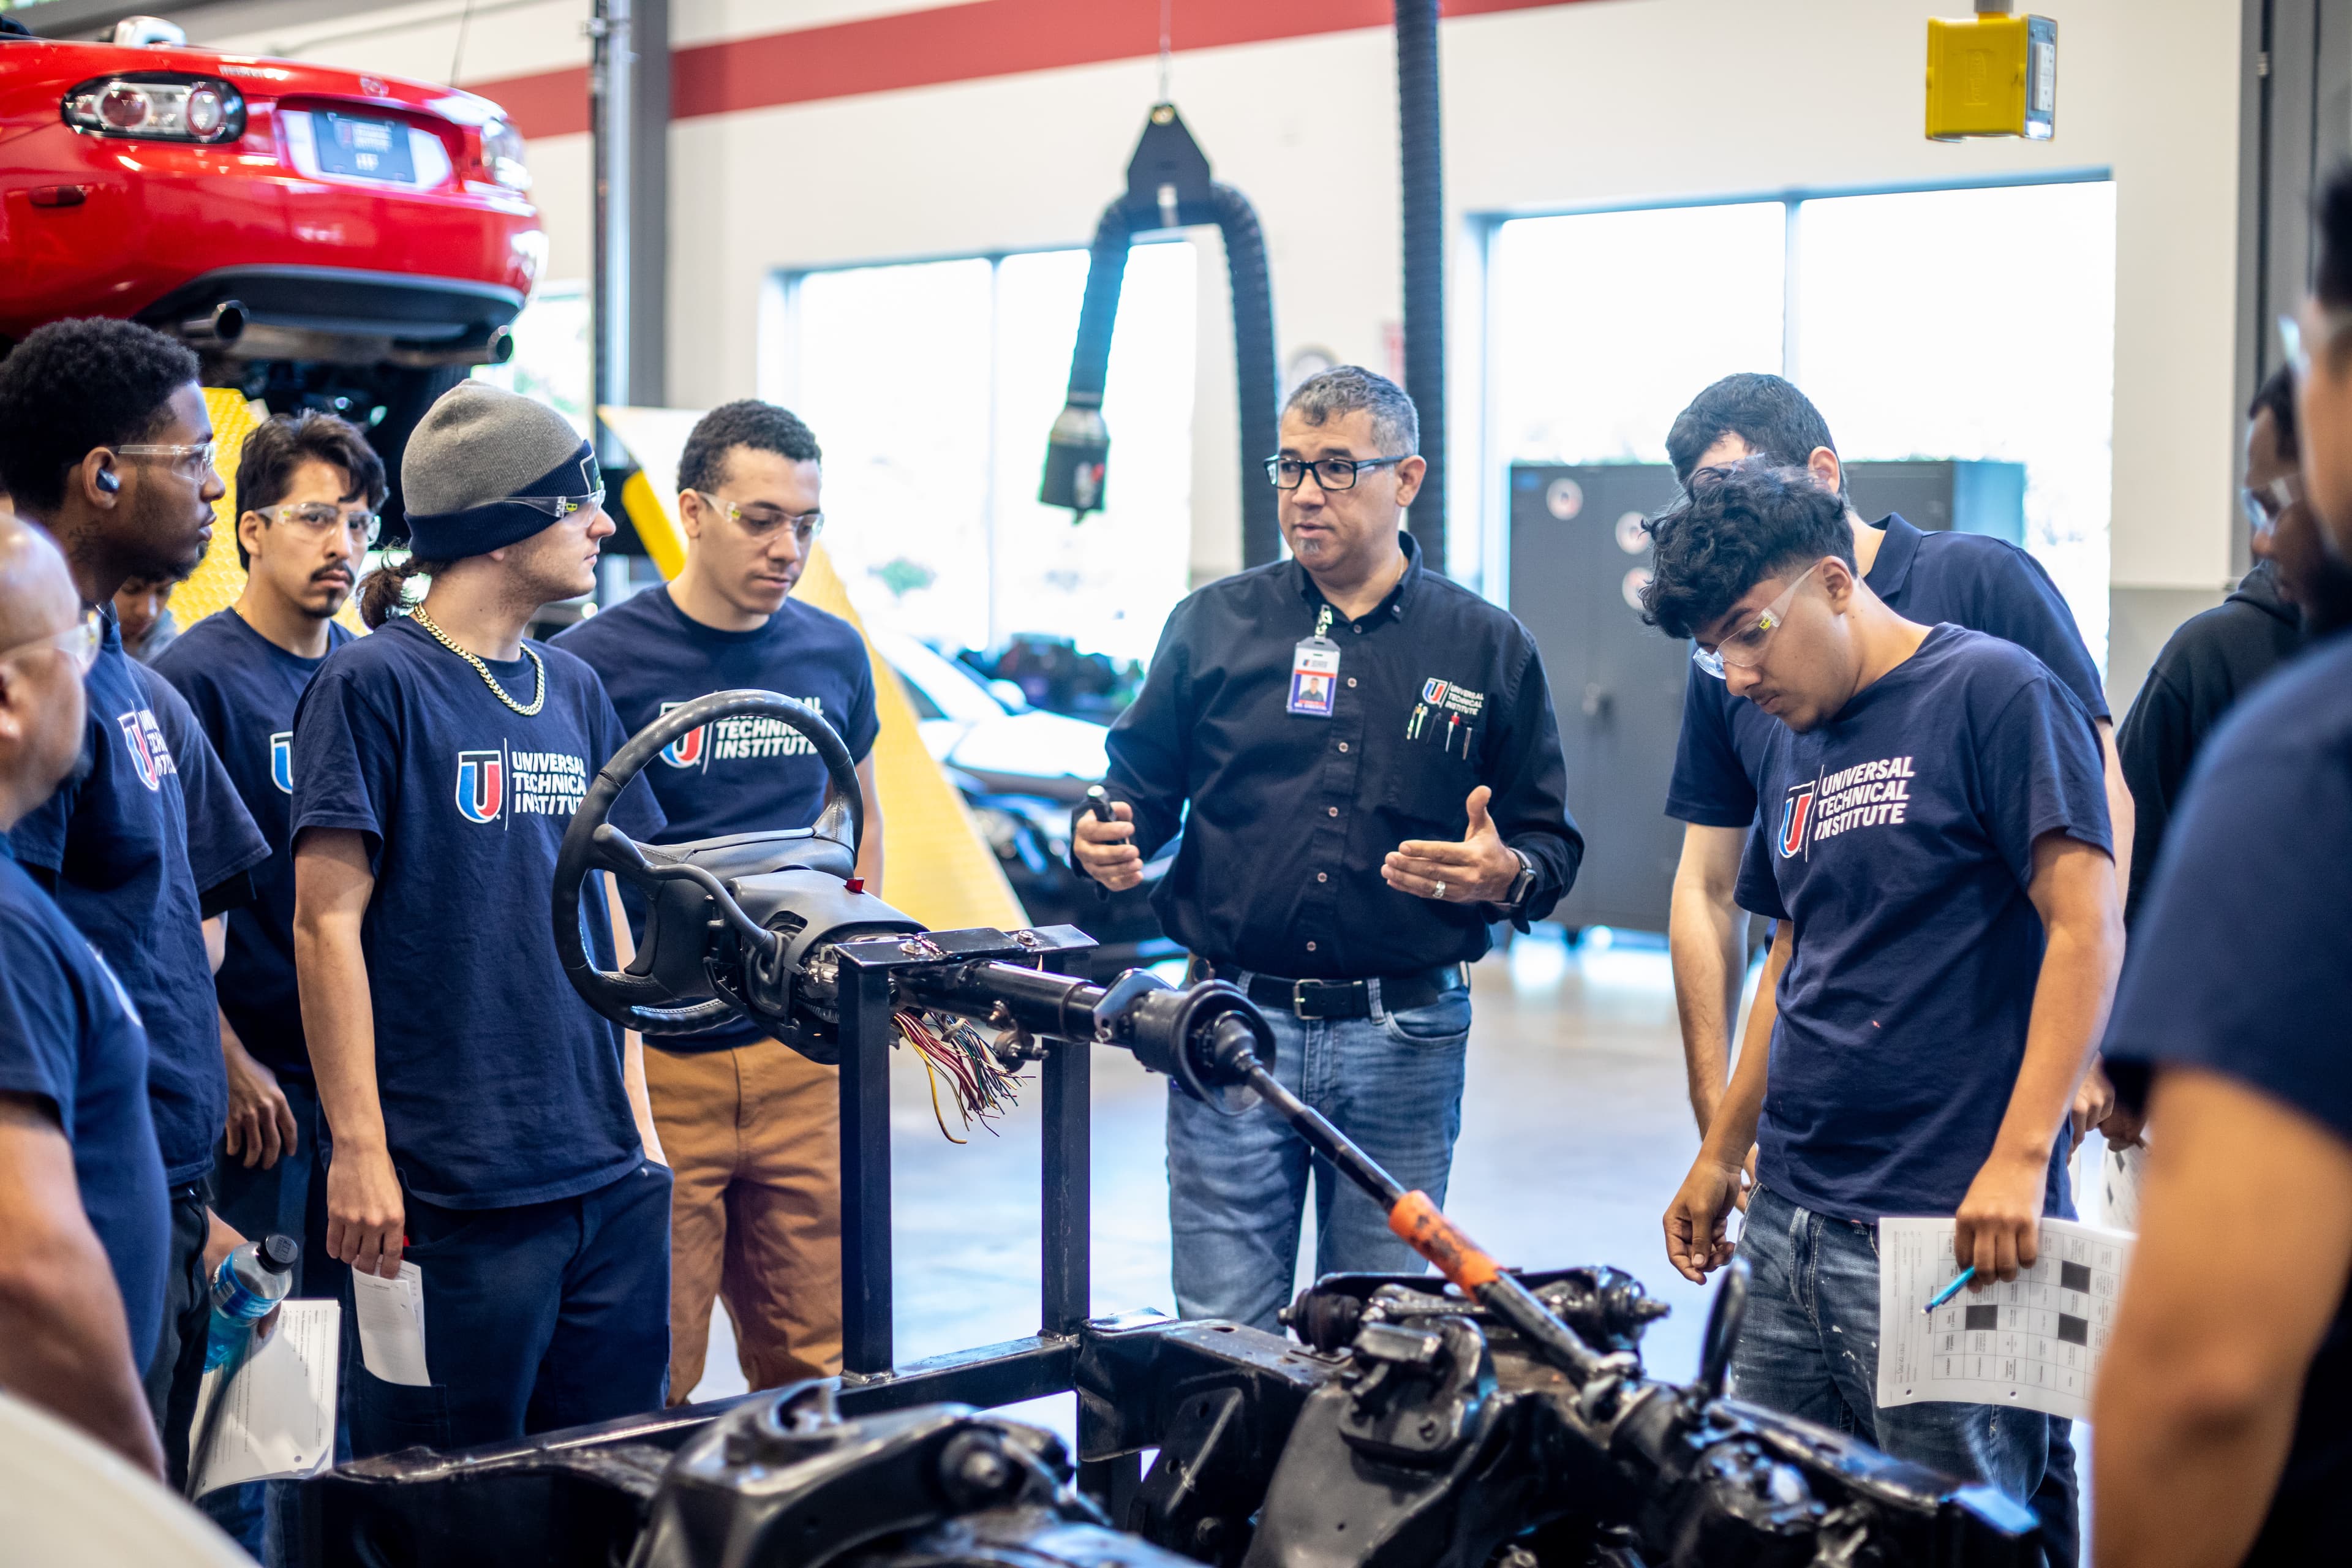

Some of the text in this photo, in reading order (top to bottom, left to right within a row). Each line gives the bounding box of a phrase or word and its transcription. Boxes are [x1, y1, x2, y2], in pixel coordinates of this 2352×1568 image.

[1448, 693, 1483, 708] TECHNICAL
[1450, 685, 1484, 700] UNIVERSAL
[1445, 700, 1479, 715] INSTITUTE
[511, 752, 586, 777] UNIVERSAL
[1822, 756, 1916, 796] UNIVERSAL
[512, 772, 587, 796] TECHNICA
[1819, 780, 1910, 819] TECHNICAL
[1814, 803, 1907, 841] INSTITUTE
